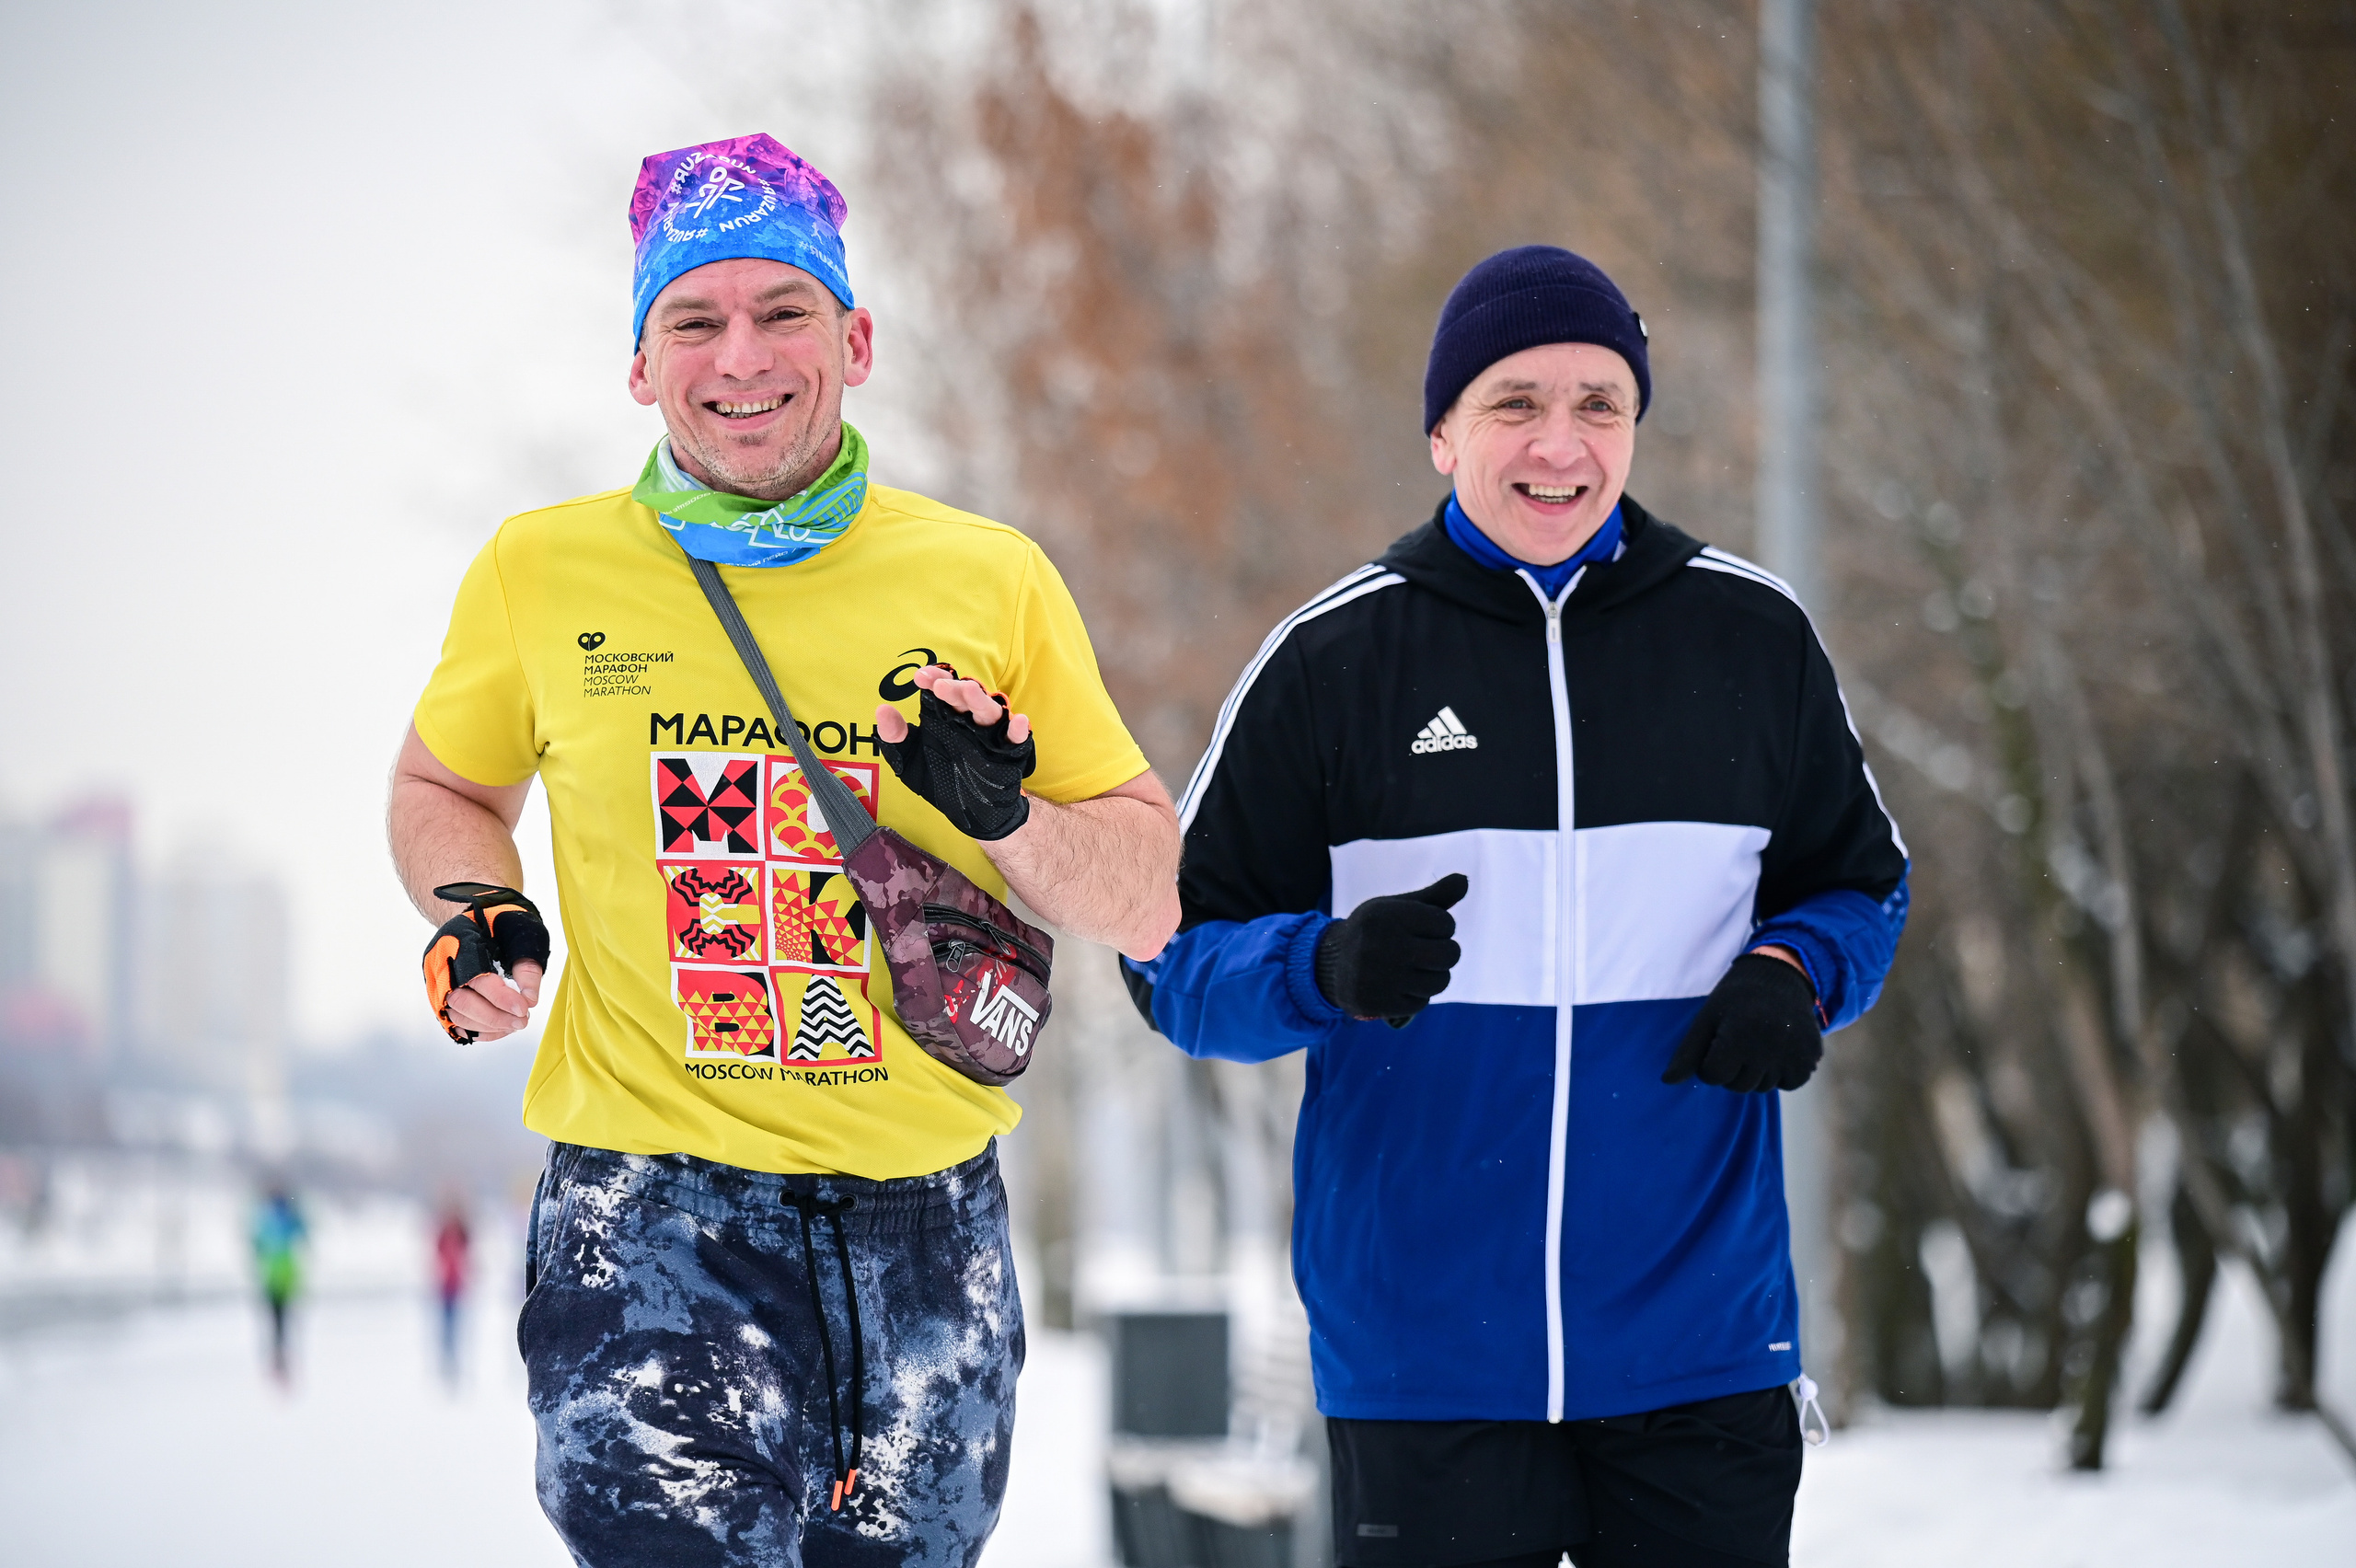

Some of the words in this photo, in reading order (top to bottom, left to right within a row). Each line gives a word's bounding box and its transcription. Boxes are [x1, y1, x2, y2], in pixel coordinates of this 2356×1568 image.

[584, 651, 675, 664] МОСКОВСКИЙ
[583, 663, 648, 675] МАРАФОН
[583, 674, 639, 686] MOSCOW
[583, 686, 652, 698] MARATHON
[1411, 734, 1479, 755] adidas
[969, 971, 1040, 1057] VANS
[685, 1064, 773, 1080] MOSCOW
[780, 1066, 889, 1087] MARATHON
